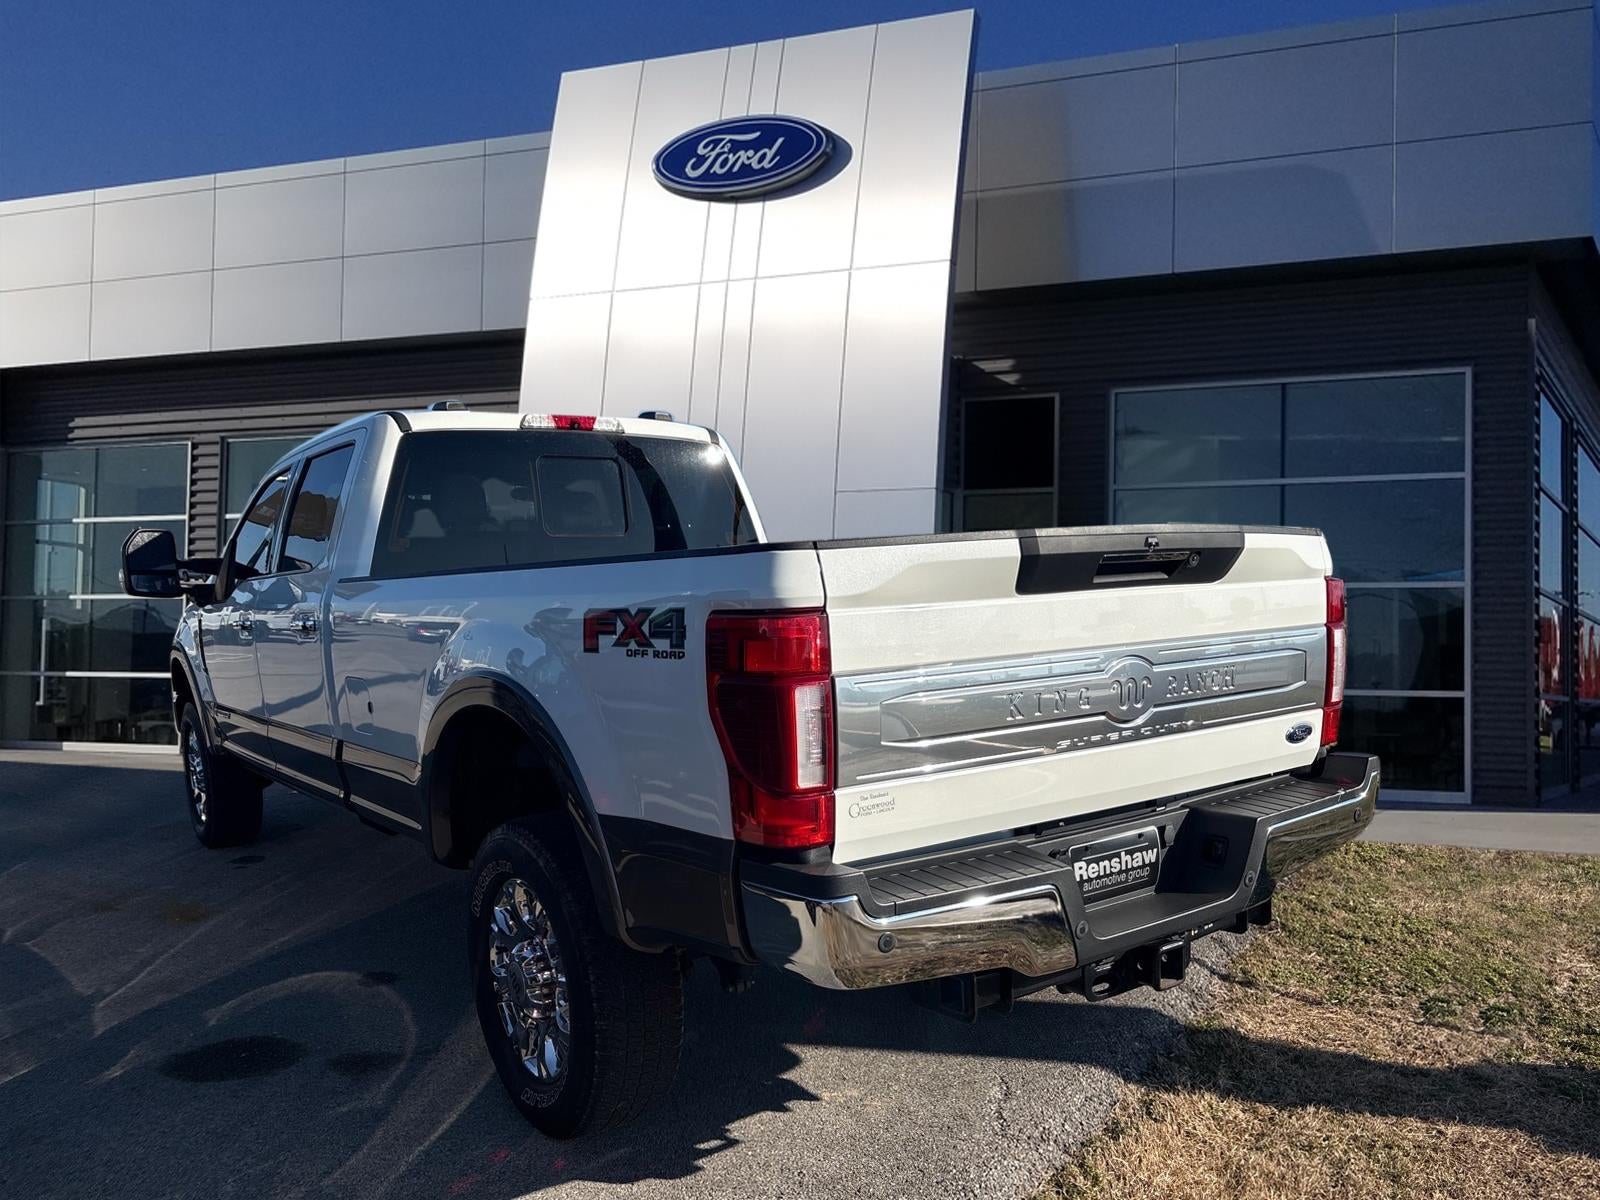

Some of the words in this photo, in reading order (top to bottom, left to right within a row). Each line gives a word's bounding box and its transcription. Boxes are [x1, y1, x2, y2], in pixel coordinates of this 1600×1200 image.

[685, 131, 785, 178] Ford
[583, 607, 687, 653] FX4
[626, 648, 649, 658] OFF
[653, 650, 686, 660] ROAD
[1006, 686, 1092, 721] KING
[1166, 664, 1236, 698] RANCH
[1073, 848, 1158, 882] Renshaw
[1083, 872, 1126, 892] automotive
[1127, 866, 1150, 883] group
